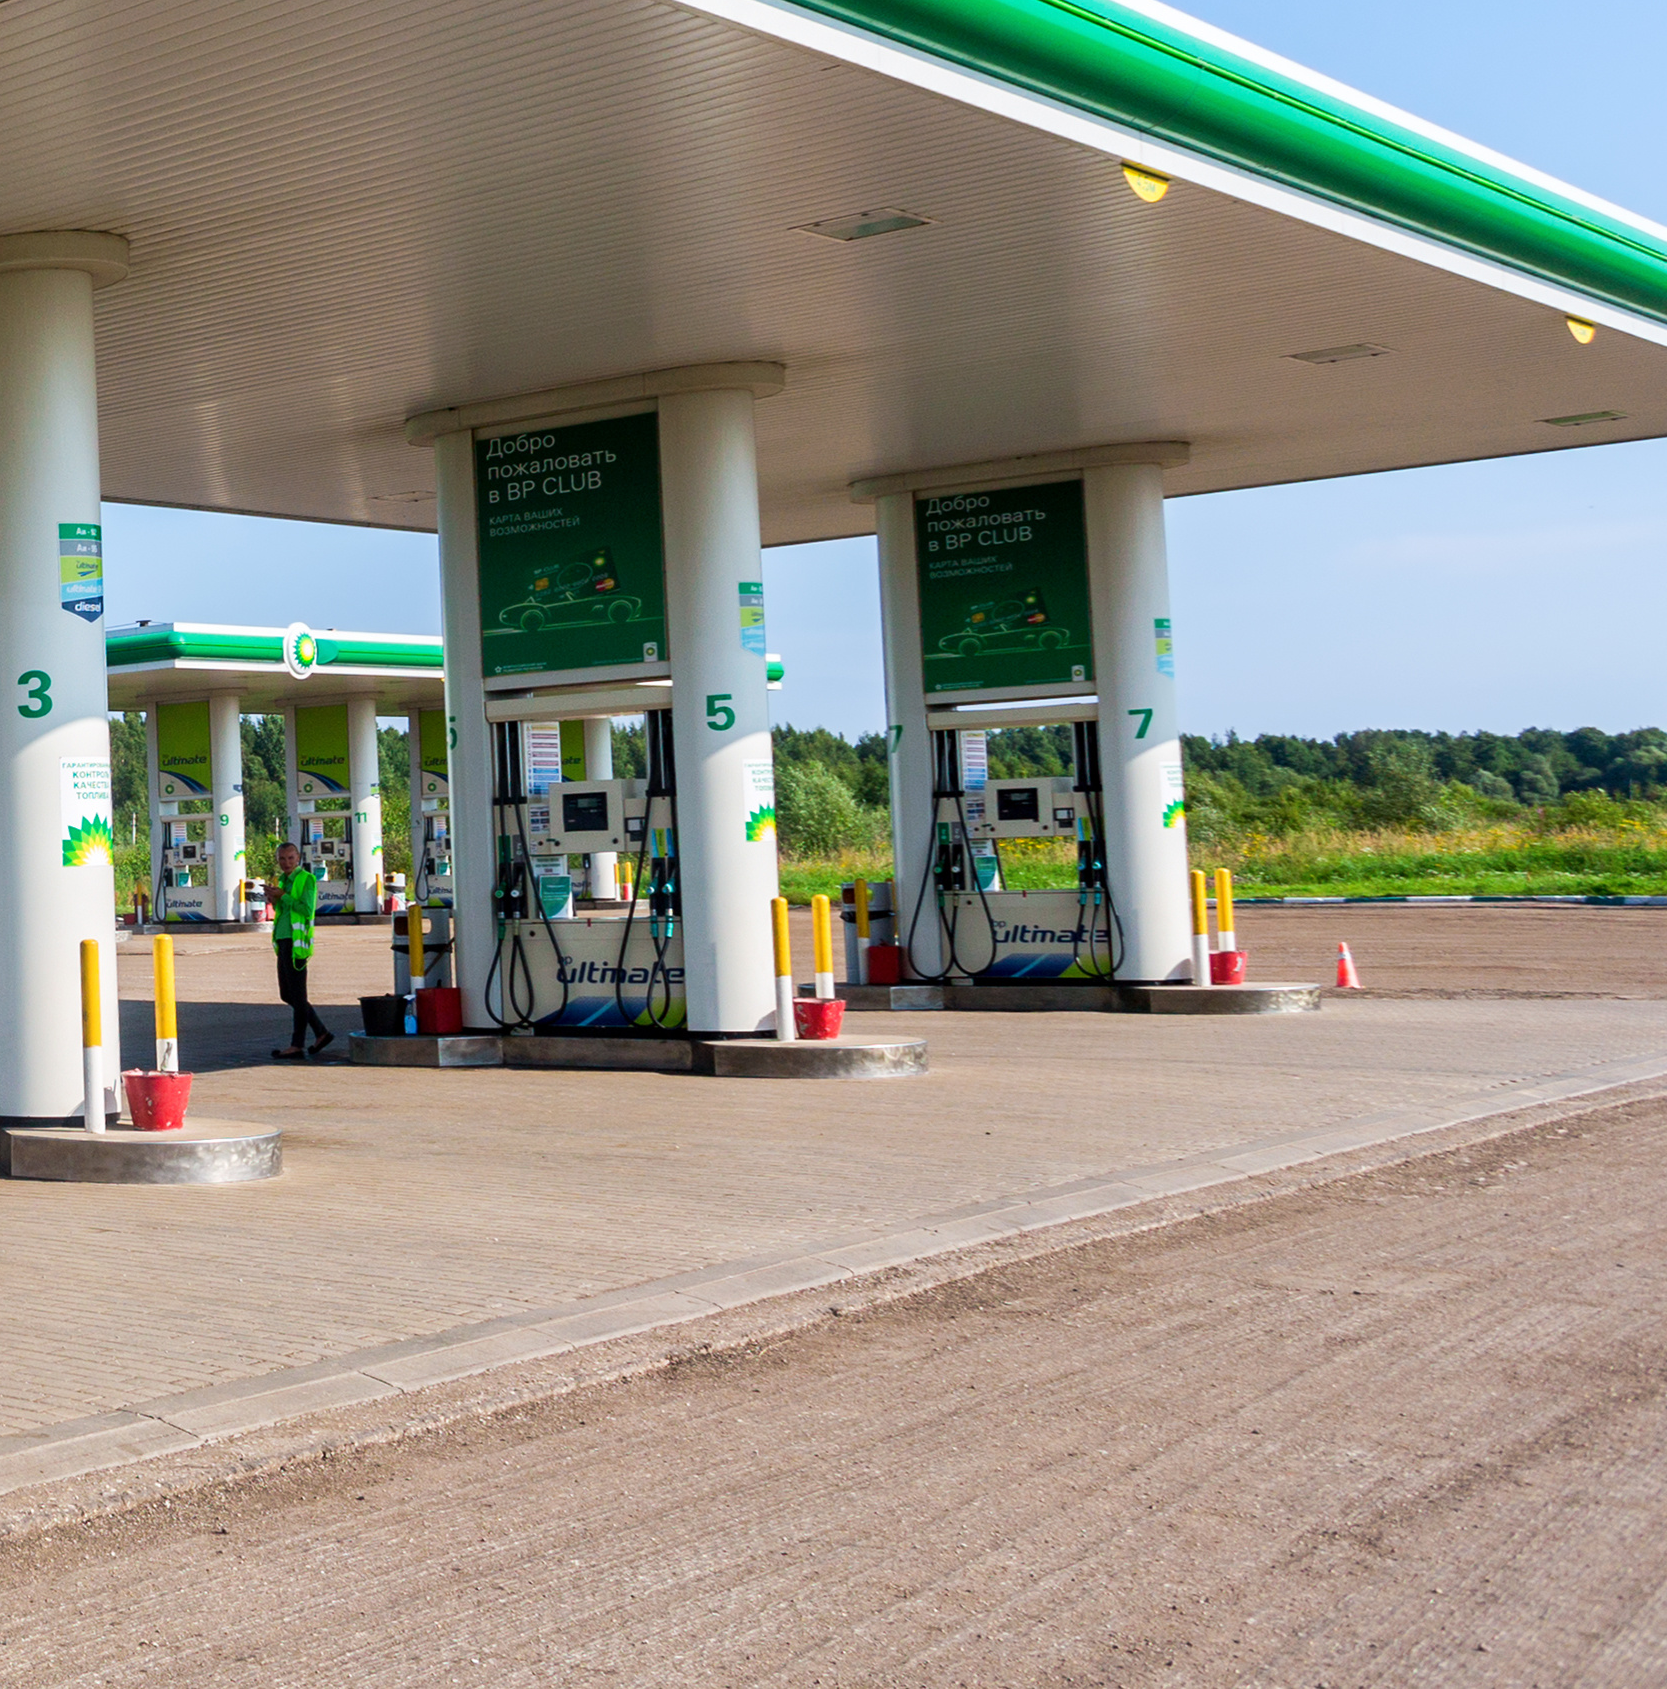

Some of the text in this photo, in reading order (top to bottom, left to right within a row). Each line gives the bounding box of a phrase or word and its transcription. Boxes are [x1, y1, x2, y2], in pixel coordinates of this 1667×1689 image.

[486, 434, 555, 460] Добро
[488, 450, 617, 480] пожаловать
[489, 470, 602, 503] в BP CLUB
[489, 508, 563, 525] КАРТА ВАШИХ
[926, 495, 989, 516] Добро
[490, 515, 580, 537] ВОЗМОЖНОСТЕЙ
[928, 509, 1046, 532] пожаловать
[928, 526, 1032, 551] в BP CLUB
[17, 670, 54, 718] 3
[706, 693, 736, 731] 5
[1128, 708, 1153, 739] 7
[219, 814, 230, 827] 9
